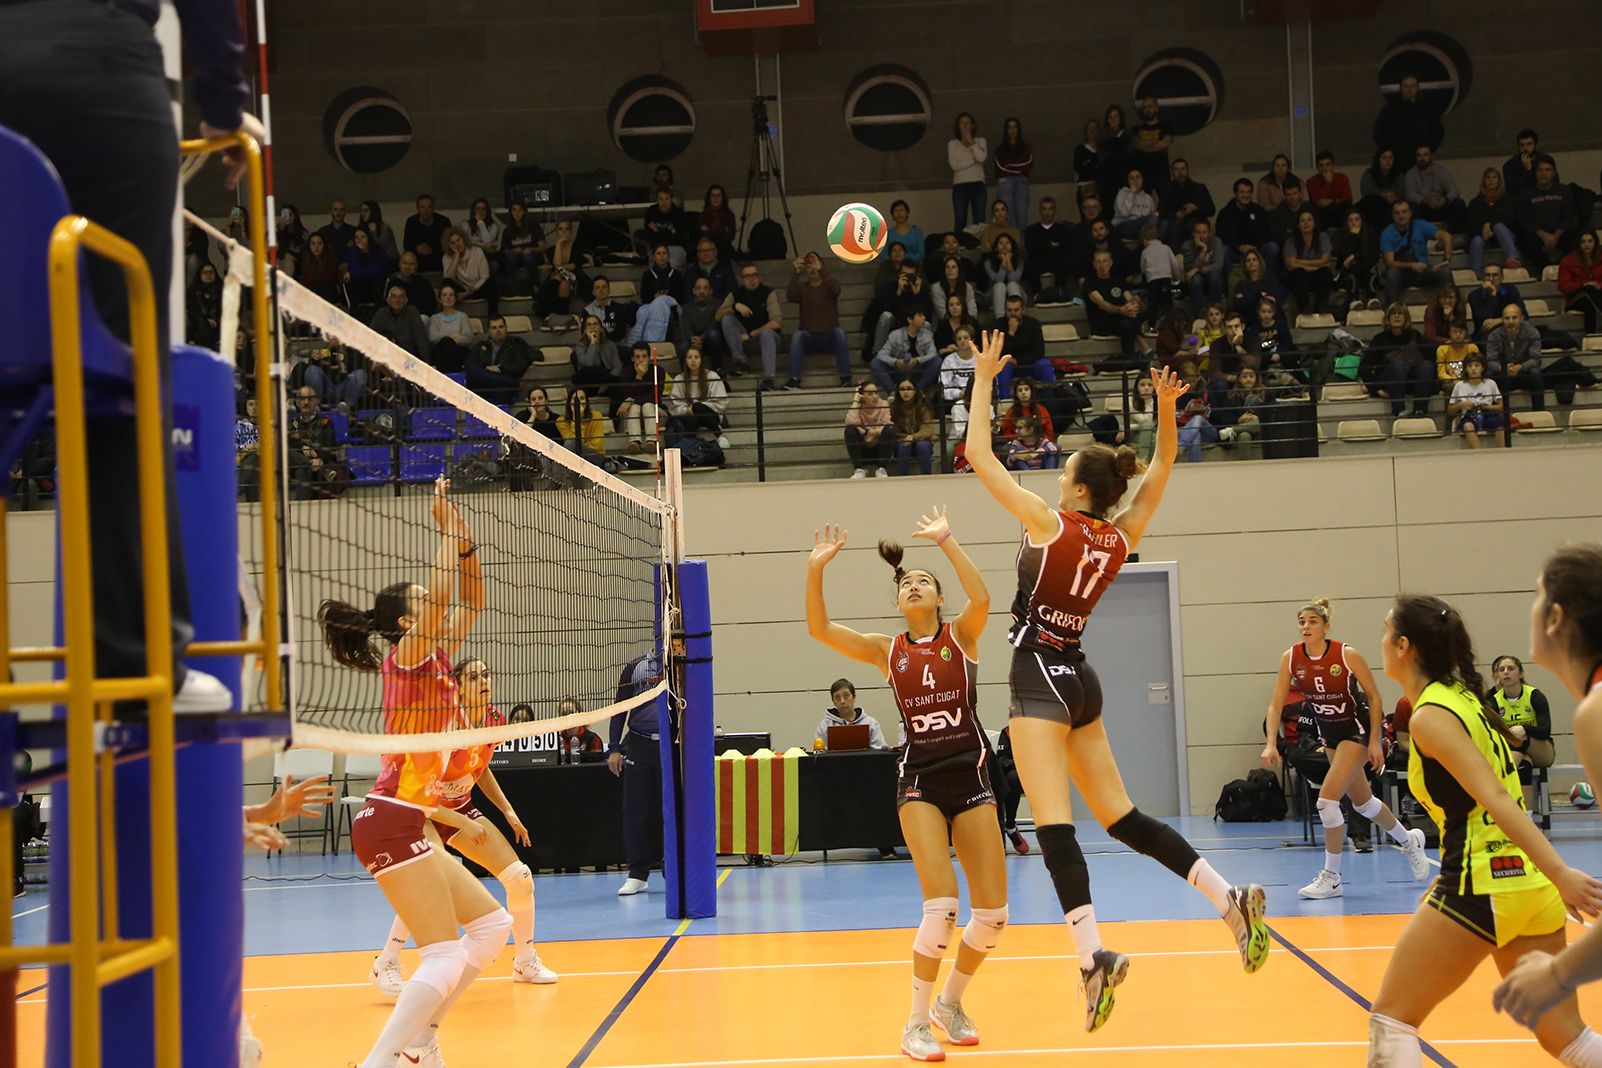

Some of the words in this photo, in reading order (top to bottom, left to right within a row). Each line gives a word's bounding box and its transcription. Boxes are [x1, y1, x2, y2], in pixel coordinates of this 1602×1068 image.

[857, 217, 868, 243] molten
[1069, 543, 1112, 600] 17
[1038, 604, 1089, 632] GRIFO
[922, 664, 936, 689] 4
[1314, 677, 1326, 693] 6
[904, 699, 913, 708] CV
[914, 694, 935, 707] SANT
[936, 689, 960, 703] CUGAT
[1311, 702, 1347, 715] DSV
[911, 707, 962, 733] DSV
[469, 747, 480, 768] 5
